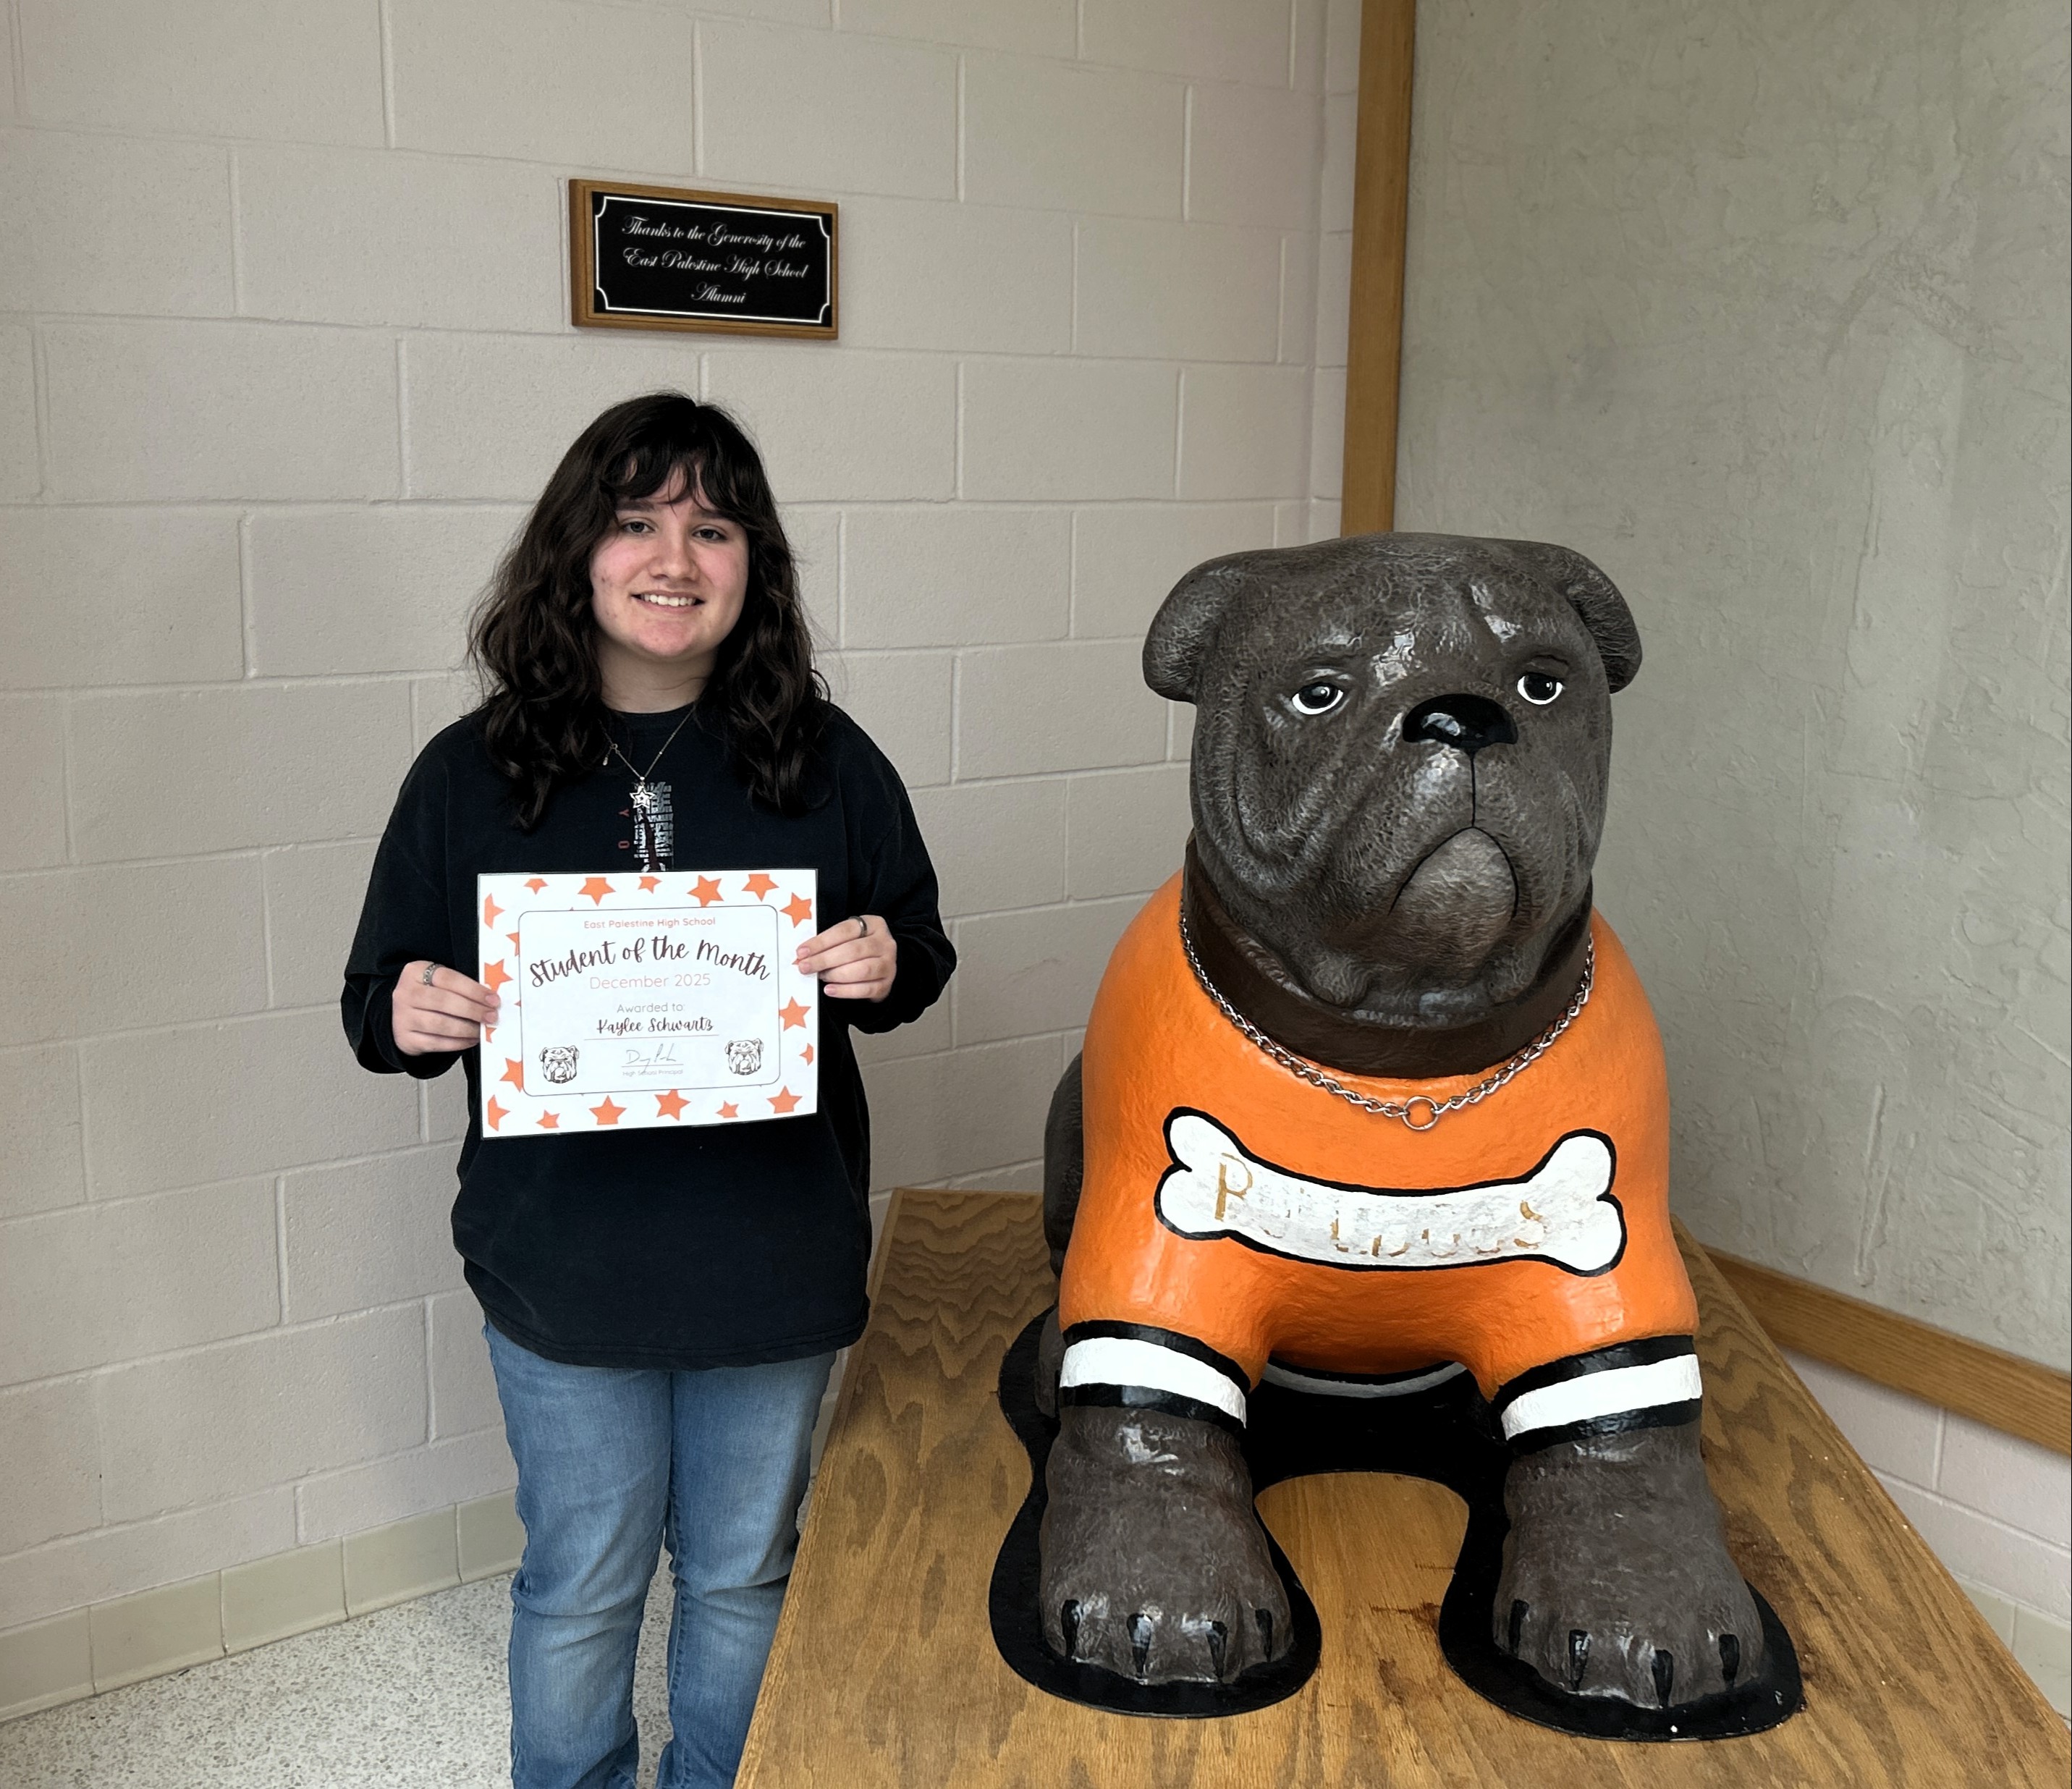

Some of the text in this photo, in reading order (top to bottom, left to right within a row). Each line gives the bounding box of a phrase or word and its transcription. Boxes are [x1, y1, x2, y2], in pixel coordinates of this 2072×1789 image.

[622, 216, 806, 253] Thanks to the Generosity of the
[622, 248, 809, 282] East Palestine High School
[691, 282, 746, 304] Alumni
[609, 919, 654, 928] Palestine
[657, 918, 680, 929] High
[682, 917, 716, 926] School
[529, 935, 771, 988] Student of the Month
[590, 973, 711, 989] December 2025
[617, 1003, 668, 1013] Awarded
[597, 1016, 714, 1036] Kaylee Schwartz
